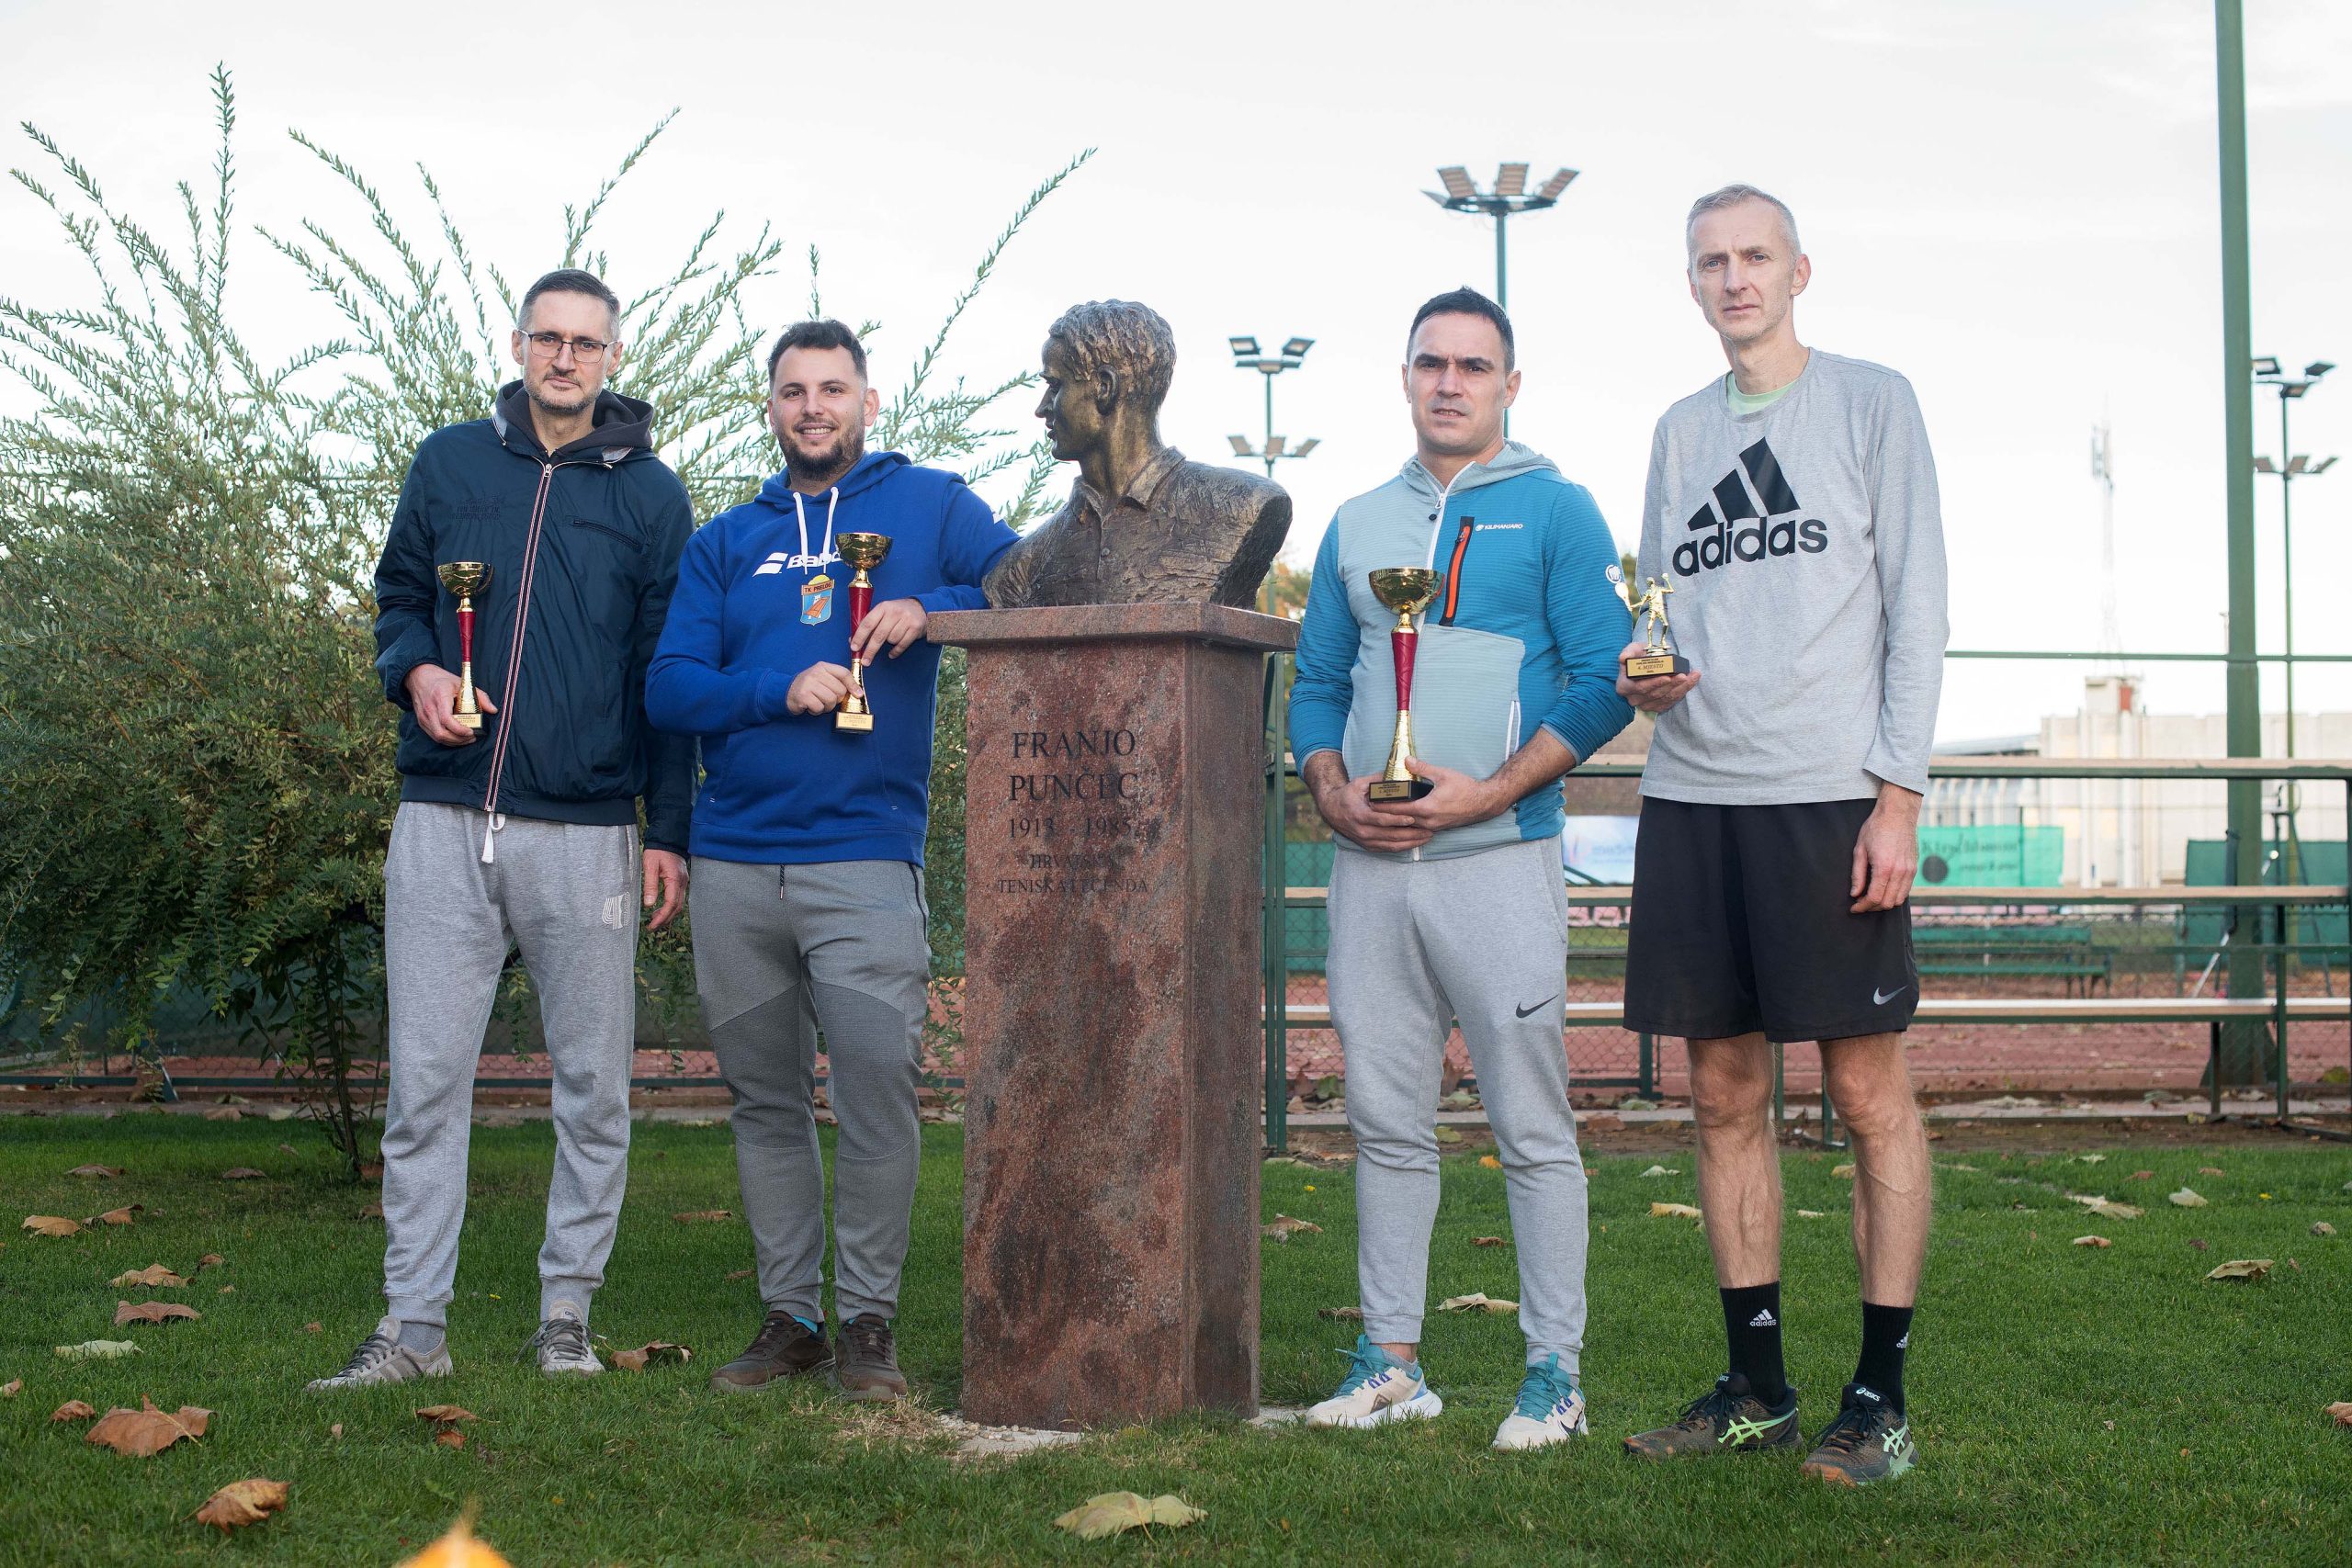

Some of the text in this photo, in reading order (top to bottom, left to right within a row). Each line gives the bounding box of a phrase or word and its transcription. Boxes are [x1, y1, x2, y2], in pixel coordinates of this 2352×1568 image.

[1672, 516, 1828, 577] adidas
[786, 551, 843, 569] Babo
[813, 581, 832, 592] PRELOG
[1012, 728, 1136, 759] FRANJO
[1010, 766, 1138, 801] PUNČEC
[1010, 818, 1056, 839] 1913
[1085, 817, 1132, 838] 1985
[997, 878, 1068, 894] TENISKA
[1749, 1318, 1777, 1327] adidas
[1863, 1390, 1881, 1402] asics
